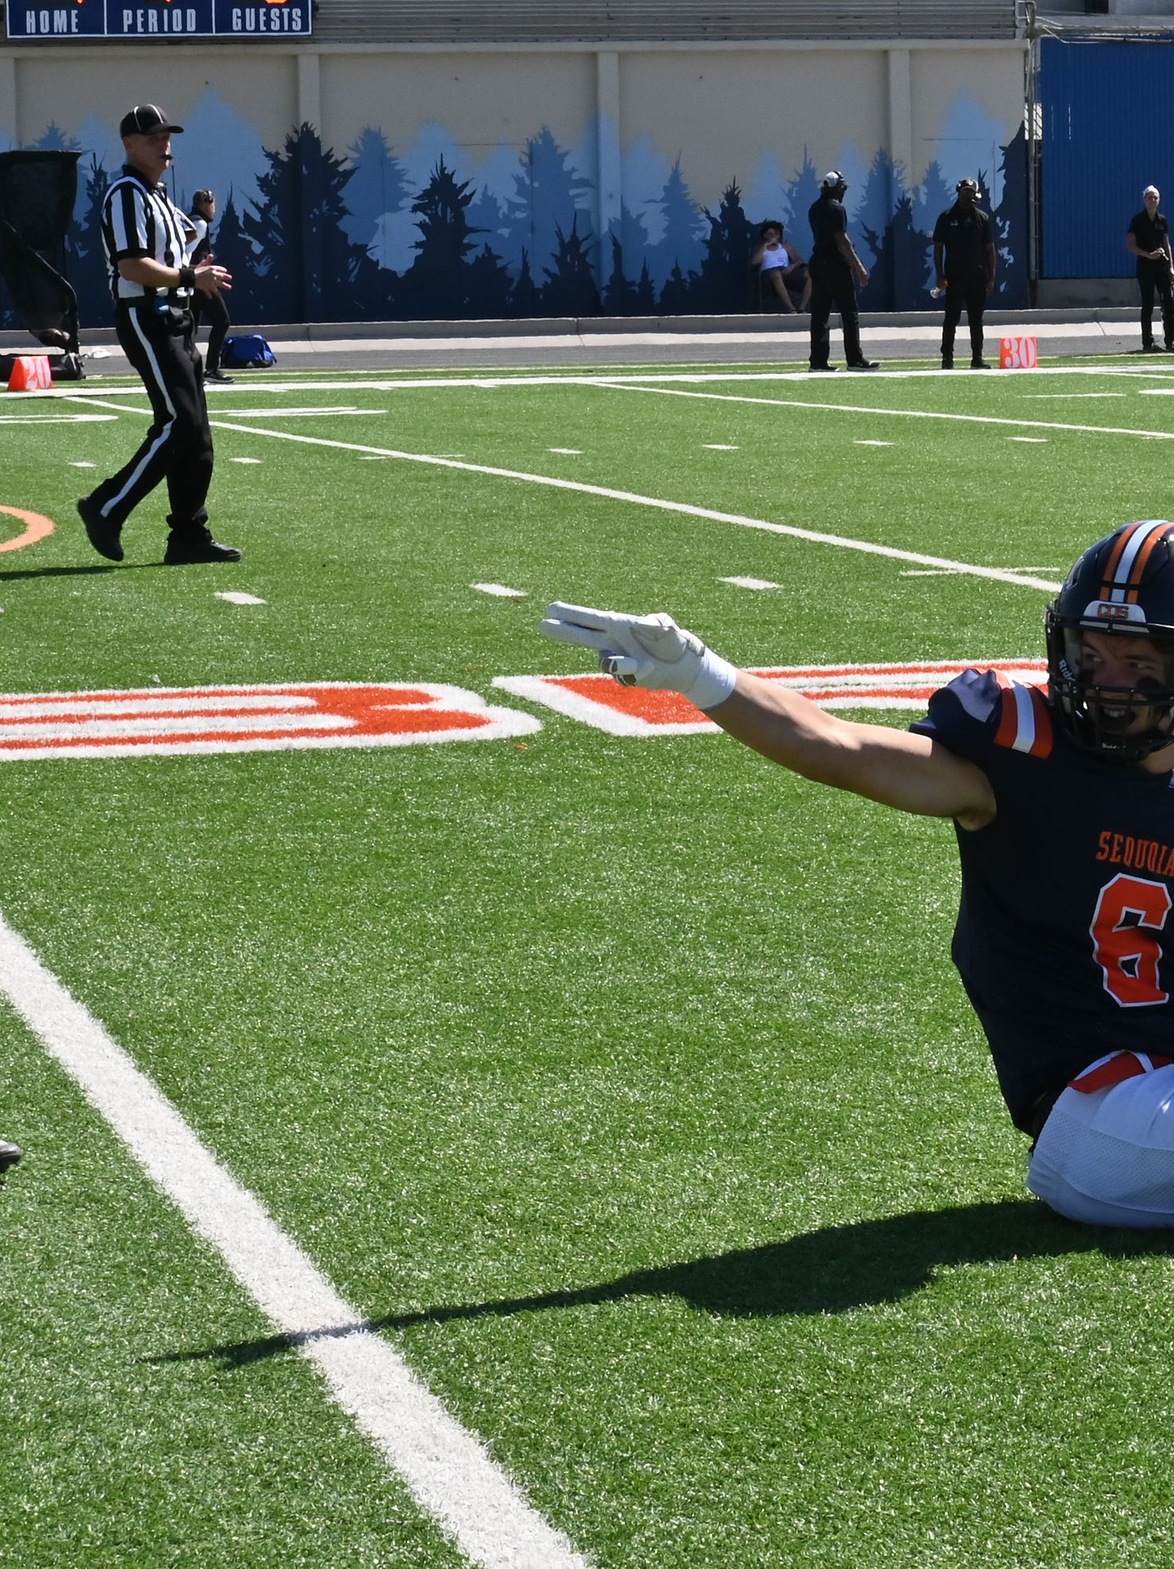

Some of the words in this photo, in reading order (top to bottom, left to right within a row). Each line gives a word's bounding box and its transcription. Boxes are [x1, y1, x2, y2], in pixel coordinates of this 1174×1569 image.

[26, 10, 78, 33] HOME
[122, 9, 197, 32] PERIOD
[232, 8, 302, 31] GUESTS
[1004, 337, 1035, 368] 30
[1098, 604, 1129, 619] COS
[1089, 872, 1173, 1008] 6
